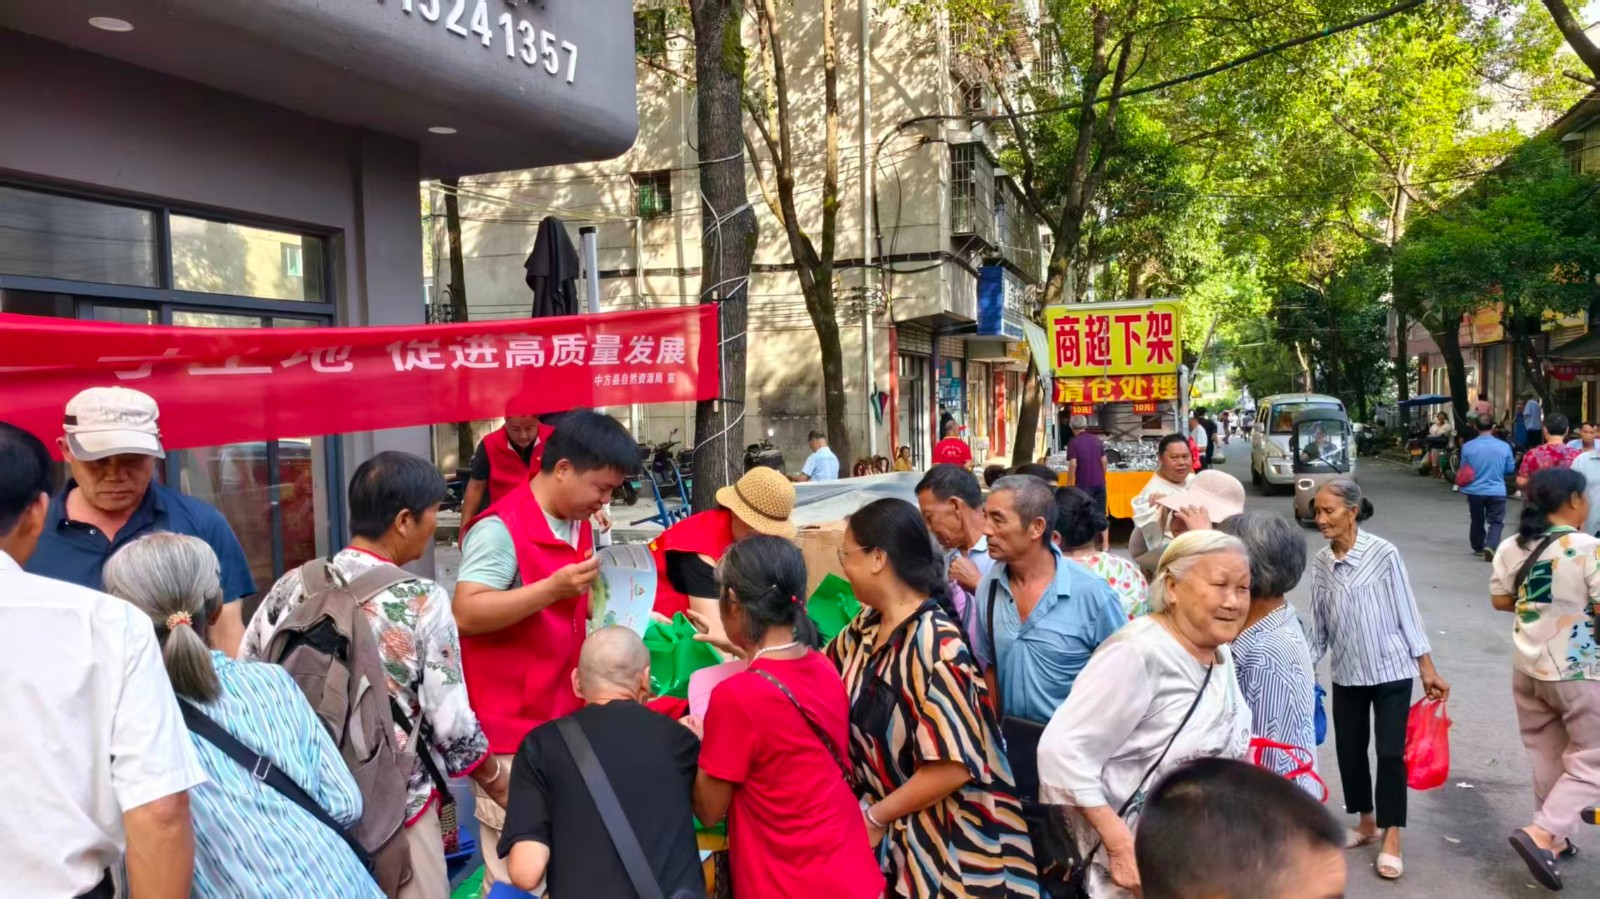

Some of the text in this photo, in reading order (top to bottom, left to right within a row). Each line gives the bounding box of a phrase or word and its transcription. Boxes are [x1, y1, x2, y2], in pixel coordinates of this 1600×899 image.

[402, 0, 578, 83] 241357
[386, 333, 685, 371] 促进高质量发展
[1054, 311, 1174, 368] 商超下架
[594, 372, 663, 387] 中方县自然资源局
[1058, 374, 1178, 402] 清仓处理
